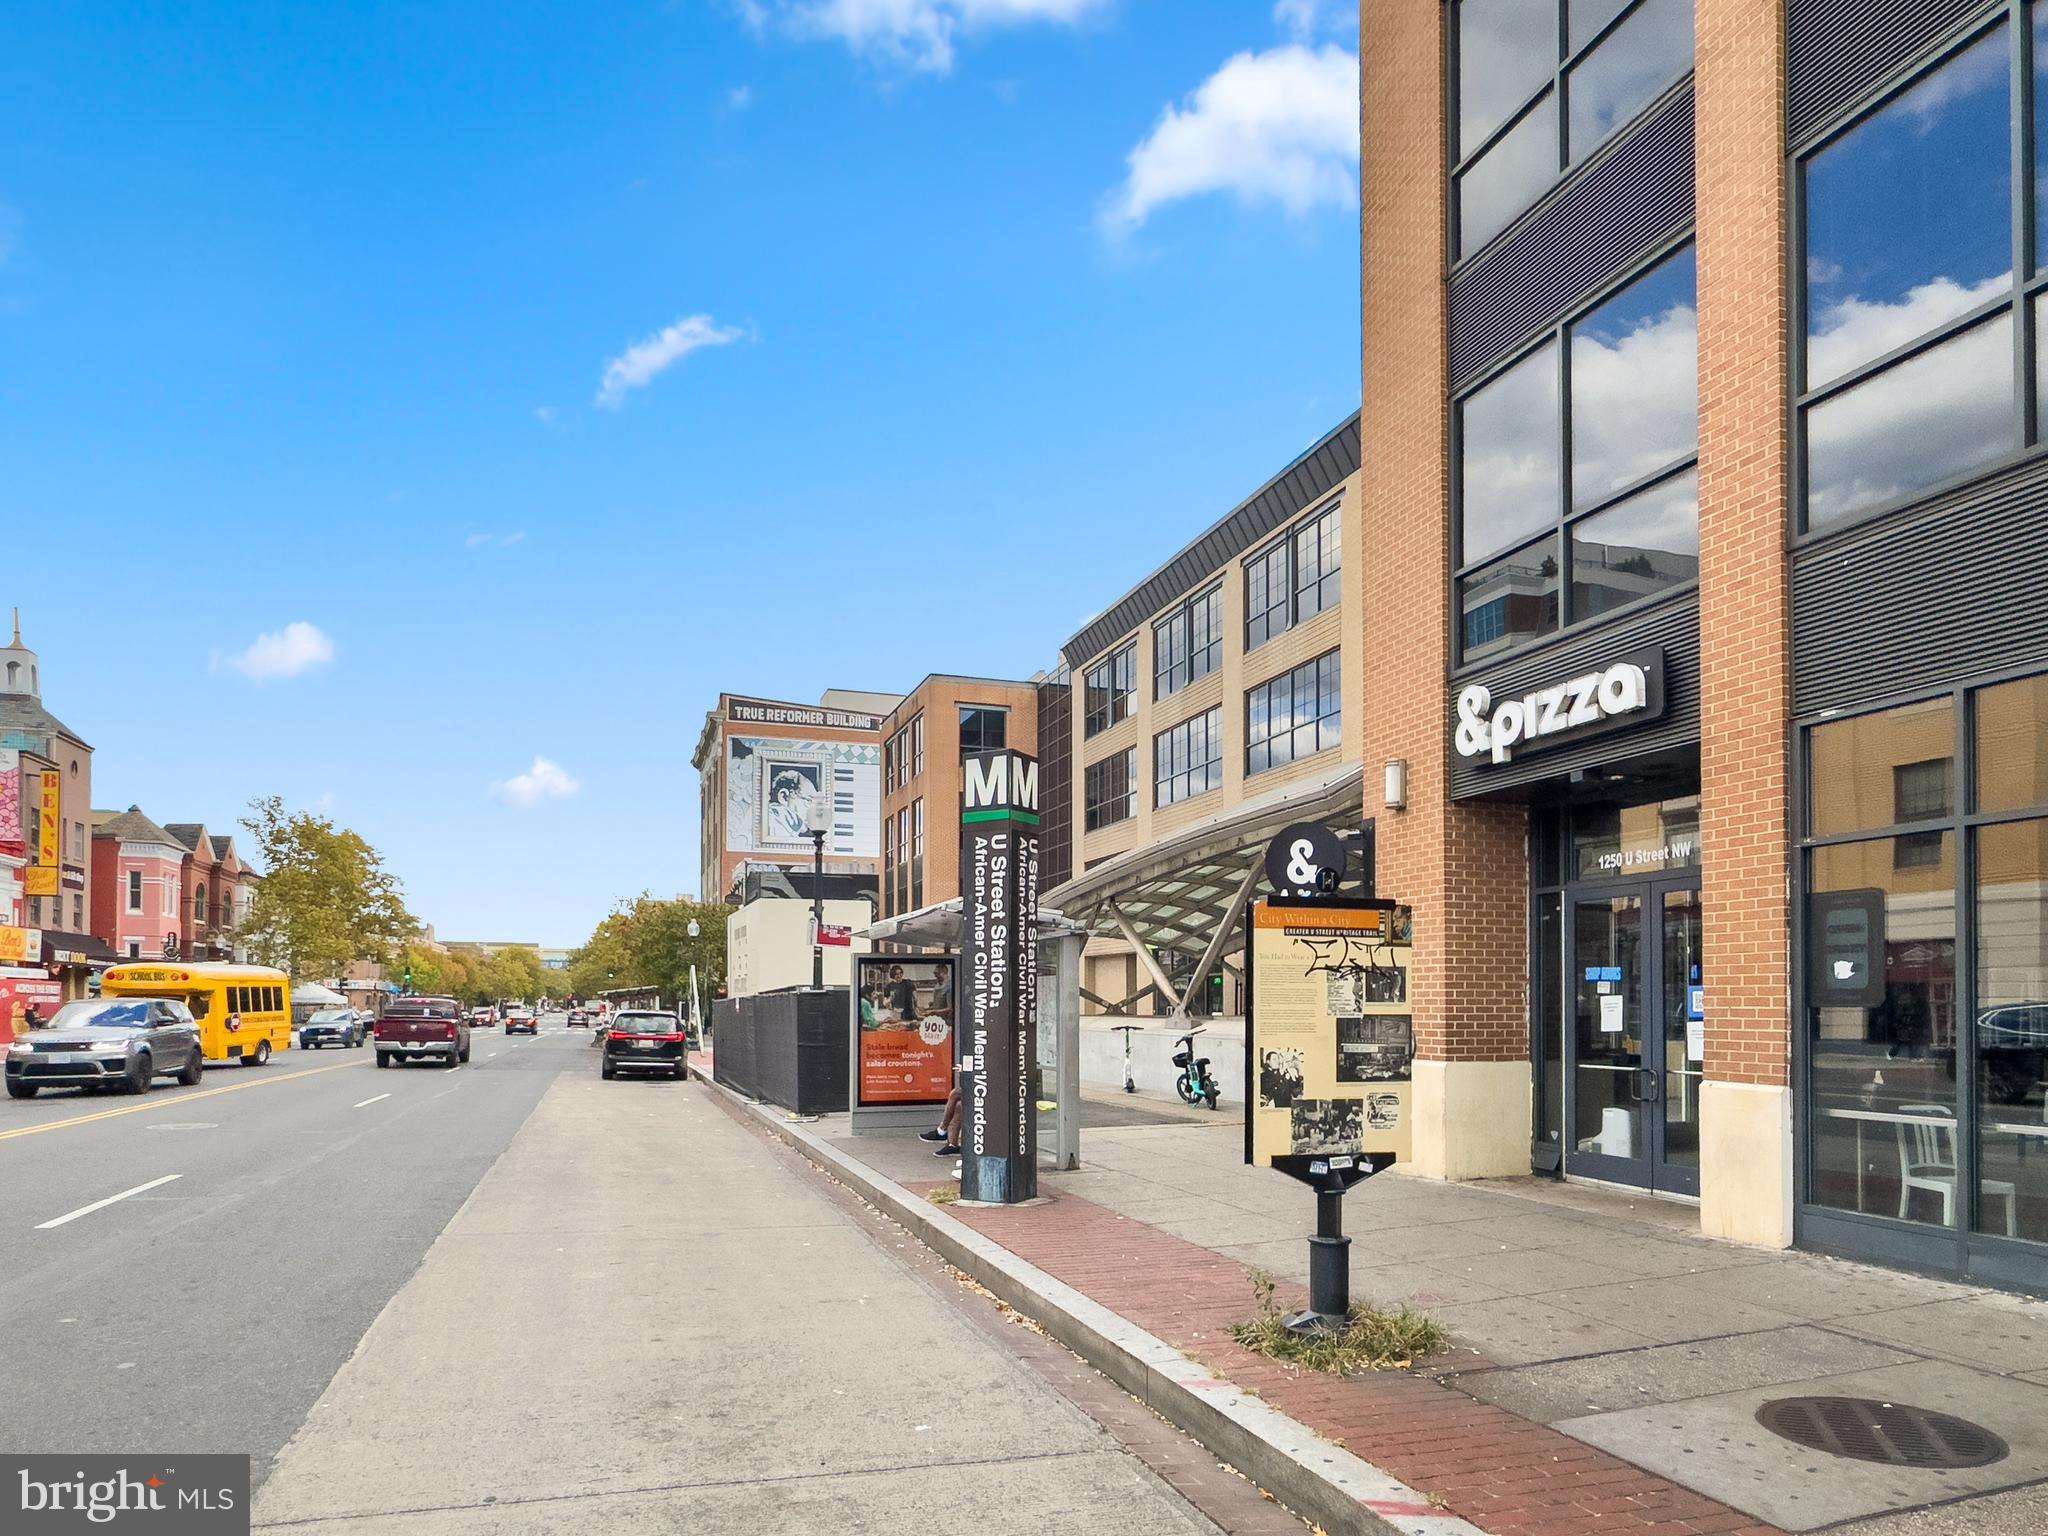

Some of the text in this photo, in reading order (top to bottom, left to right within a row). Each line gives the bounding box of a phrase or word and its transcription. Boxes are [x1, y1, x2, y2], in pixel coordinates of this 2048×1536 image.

[735, 706, 871, 728] TRUE REFORMER BUILDING
[1455, 663, 1646, 764] &pizza
[965, 755, 1008, 808] M
[1012, 756, 1039, 811] M
[43, 773, 58, 861] BEN'S
[1028, 838, 1039, 854] U
[1286, 838, 1318, 885] &
[1598, 841, 1692, 870] 1250 U Street NW
[1028, 859, 1039, 921] Street
[989, 834, 1008, 1008] U Street Station,
[1259, 913, 1280, 924] City
[1285, 913, 1320, 925] Within
[1330, 915, 1351, 927] City
[129, 971, 166, 981] SCHOOL BUS
[973, 836, 988, 1156] African-Amer Civil War Mem'l/Cardozo
[1018, 836, 1028, 1156] African-Amer Civil War Mem'l/Cardozo
[924, 1021, 944, 1033] YOU
[866, 1043, 909, 1051] Stale bread
[866, 1051, 934, 1060] becomes tonight's
[866, 1059, 886, 1067] salad
